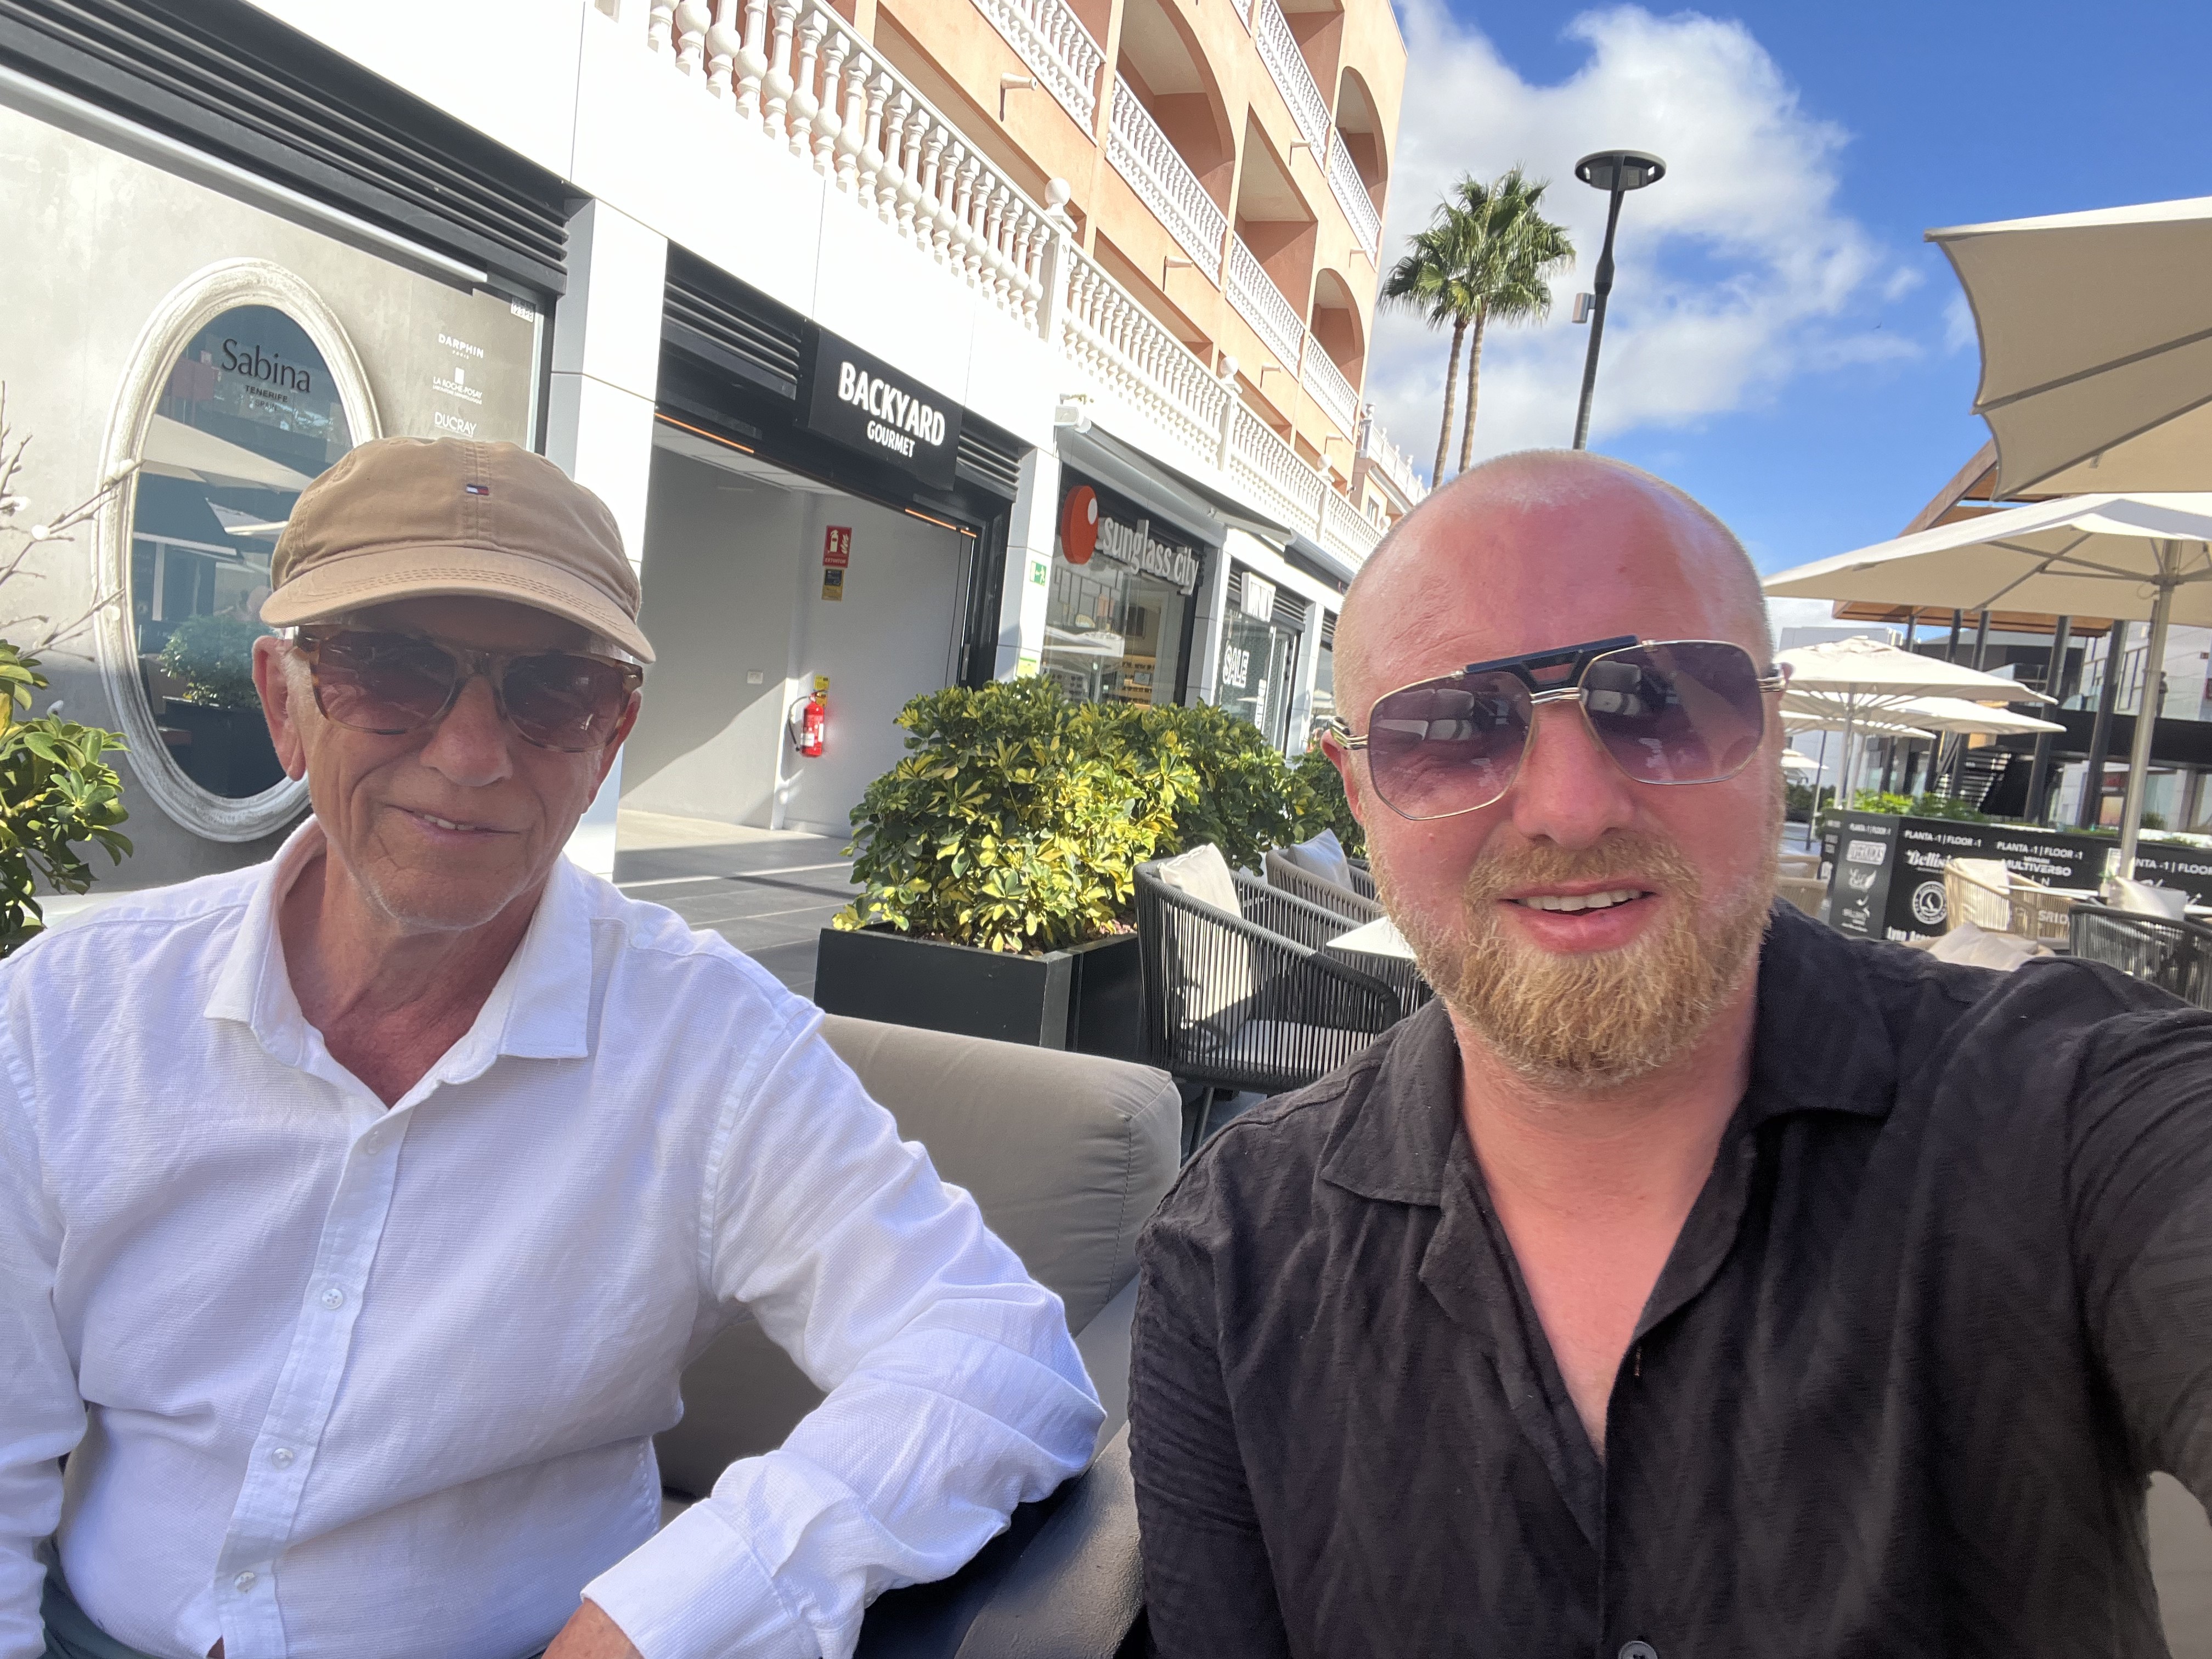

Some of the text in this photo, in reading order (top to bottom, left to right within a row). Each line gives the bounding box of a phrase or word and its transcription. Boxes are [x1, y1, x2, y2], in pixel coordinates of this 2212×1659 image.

[438, 333, 484, 358] DARPHIN
[222, 338, 311, 393] Sabina
[433, 376, 441, 385] LA
[245, 385, 288, 402] TENERIFE
[255, 399, 278, 411] SPAIN
[838, 362, 946, 445] BACKYARD
[435, 411, 477, 435] DUCRAY
[867, 420, 916, 458] GOURMET
[1102, 517, 1200, 596] sunglass city
[1222, 645, 1250, 688] SALE
[1904, 830, 1933, 841] PLANTA
[1948, 836, 1973, 846] FLOOR
[1997, 841, 2028, 853] PLANTA
[2045, 847, 2073, 859] FLOOR
[2136, 858, 2157, 869] NTA
